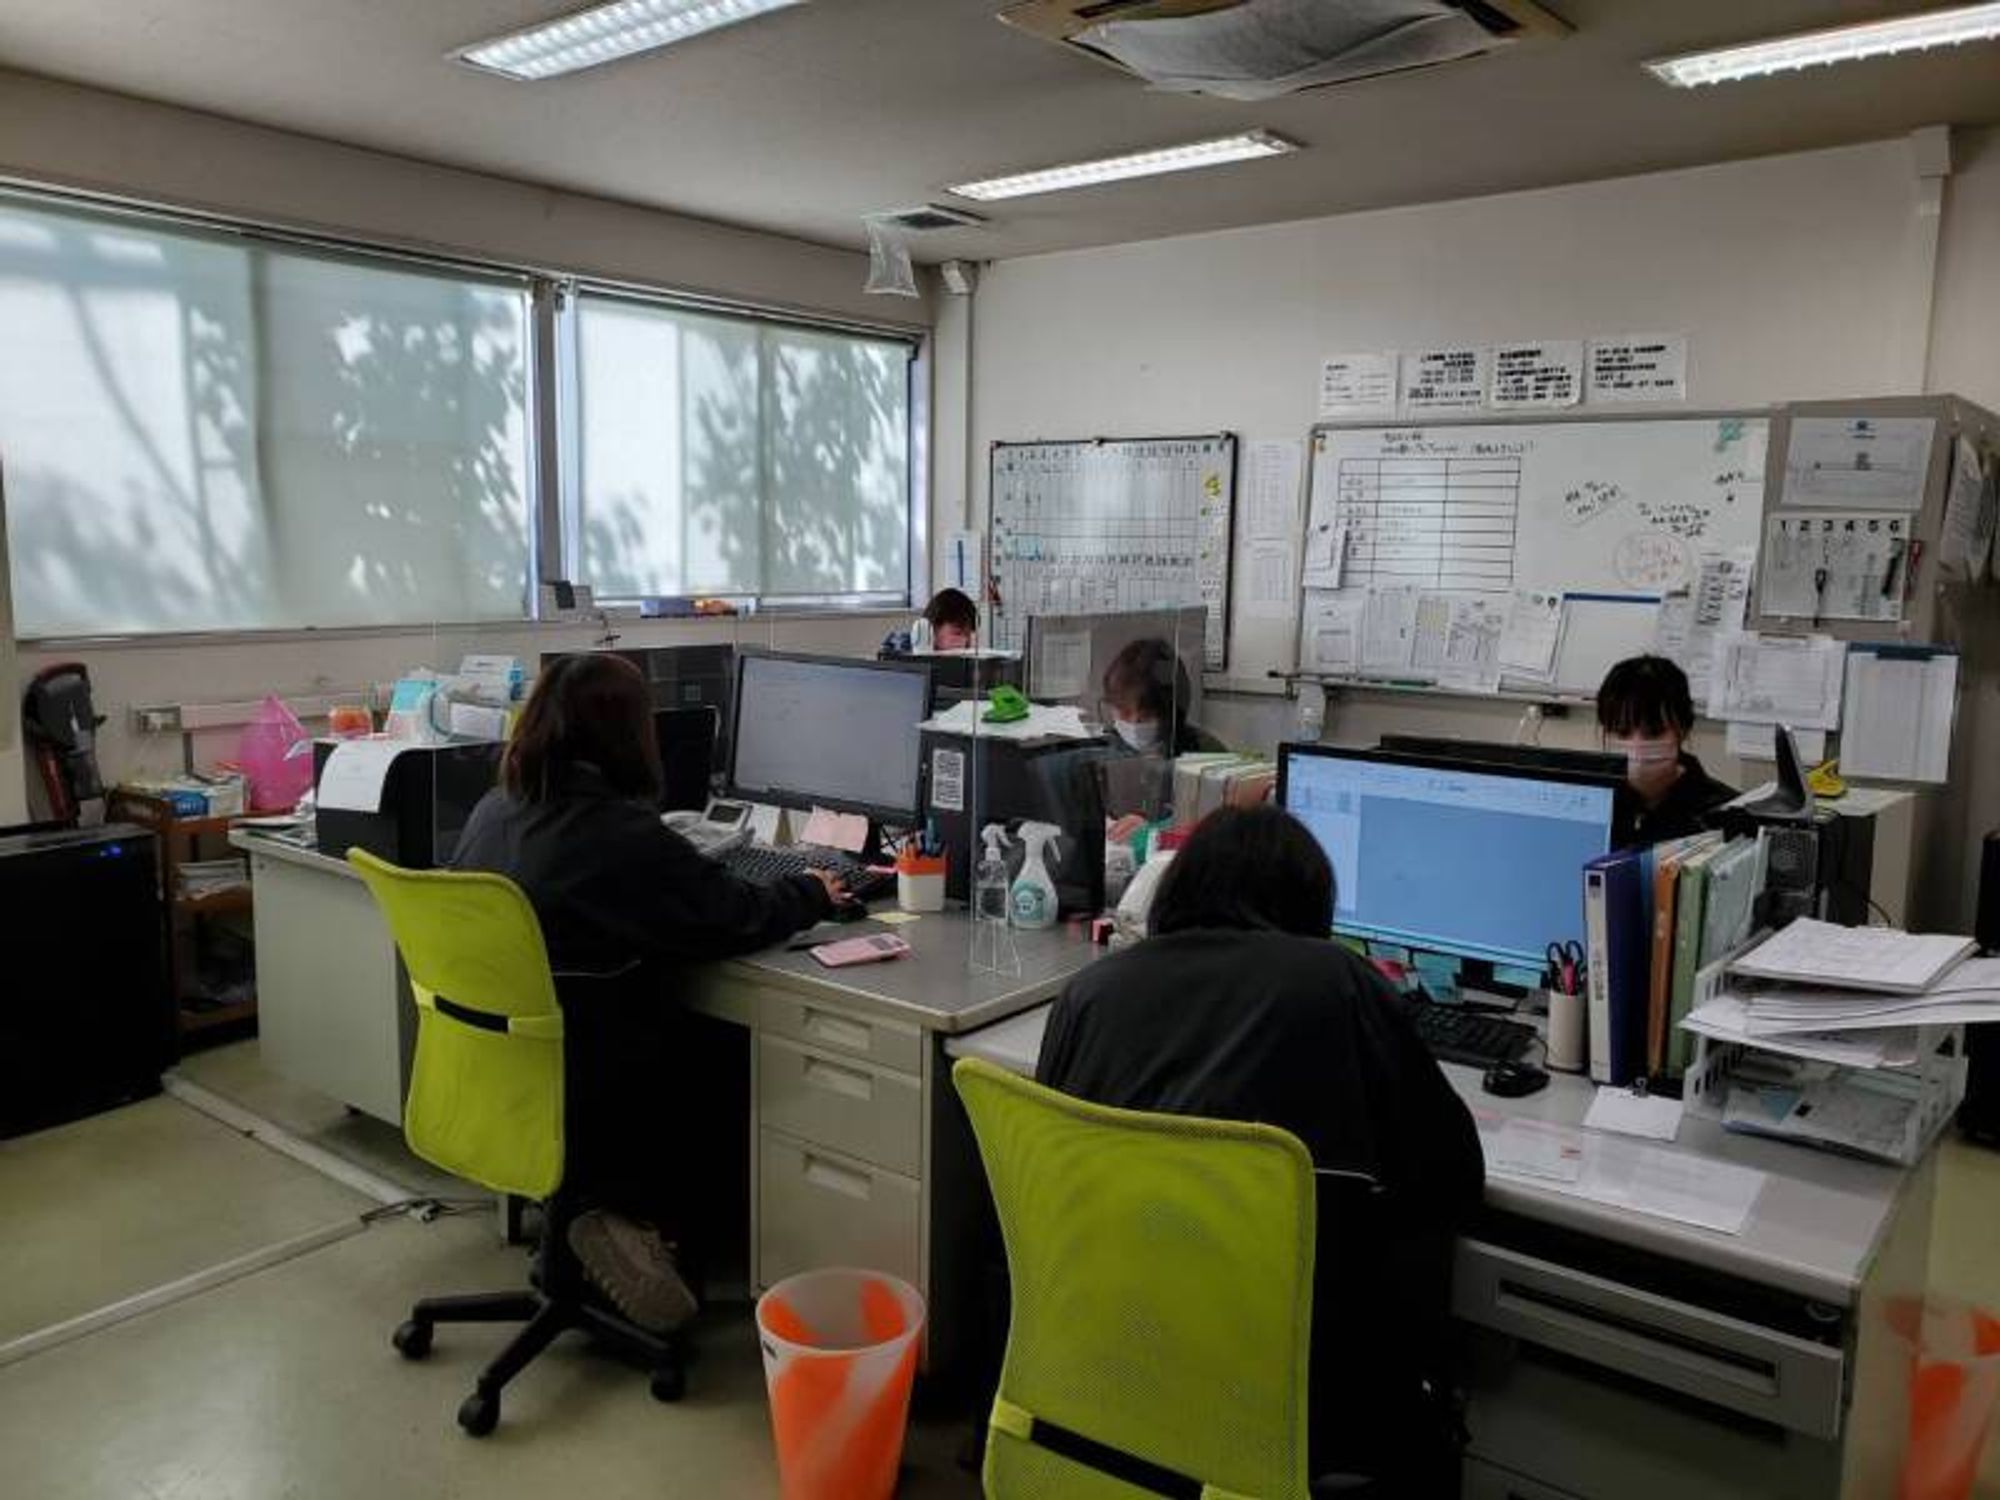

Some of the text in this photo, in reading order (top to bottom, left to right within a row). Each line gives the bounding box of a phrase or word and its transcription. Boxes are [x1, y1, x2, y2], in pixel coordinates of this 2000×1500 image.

[1800, 520, 1810, 531] 2
[1823, 520, 1833, 531] 3
[1844, 520, 1854, 531] 4
[1868, 520, 1878, 532] 5
[1889, 520, 1899, 532] 6
